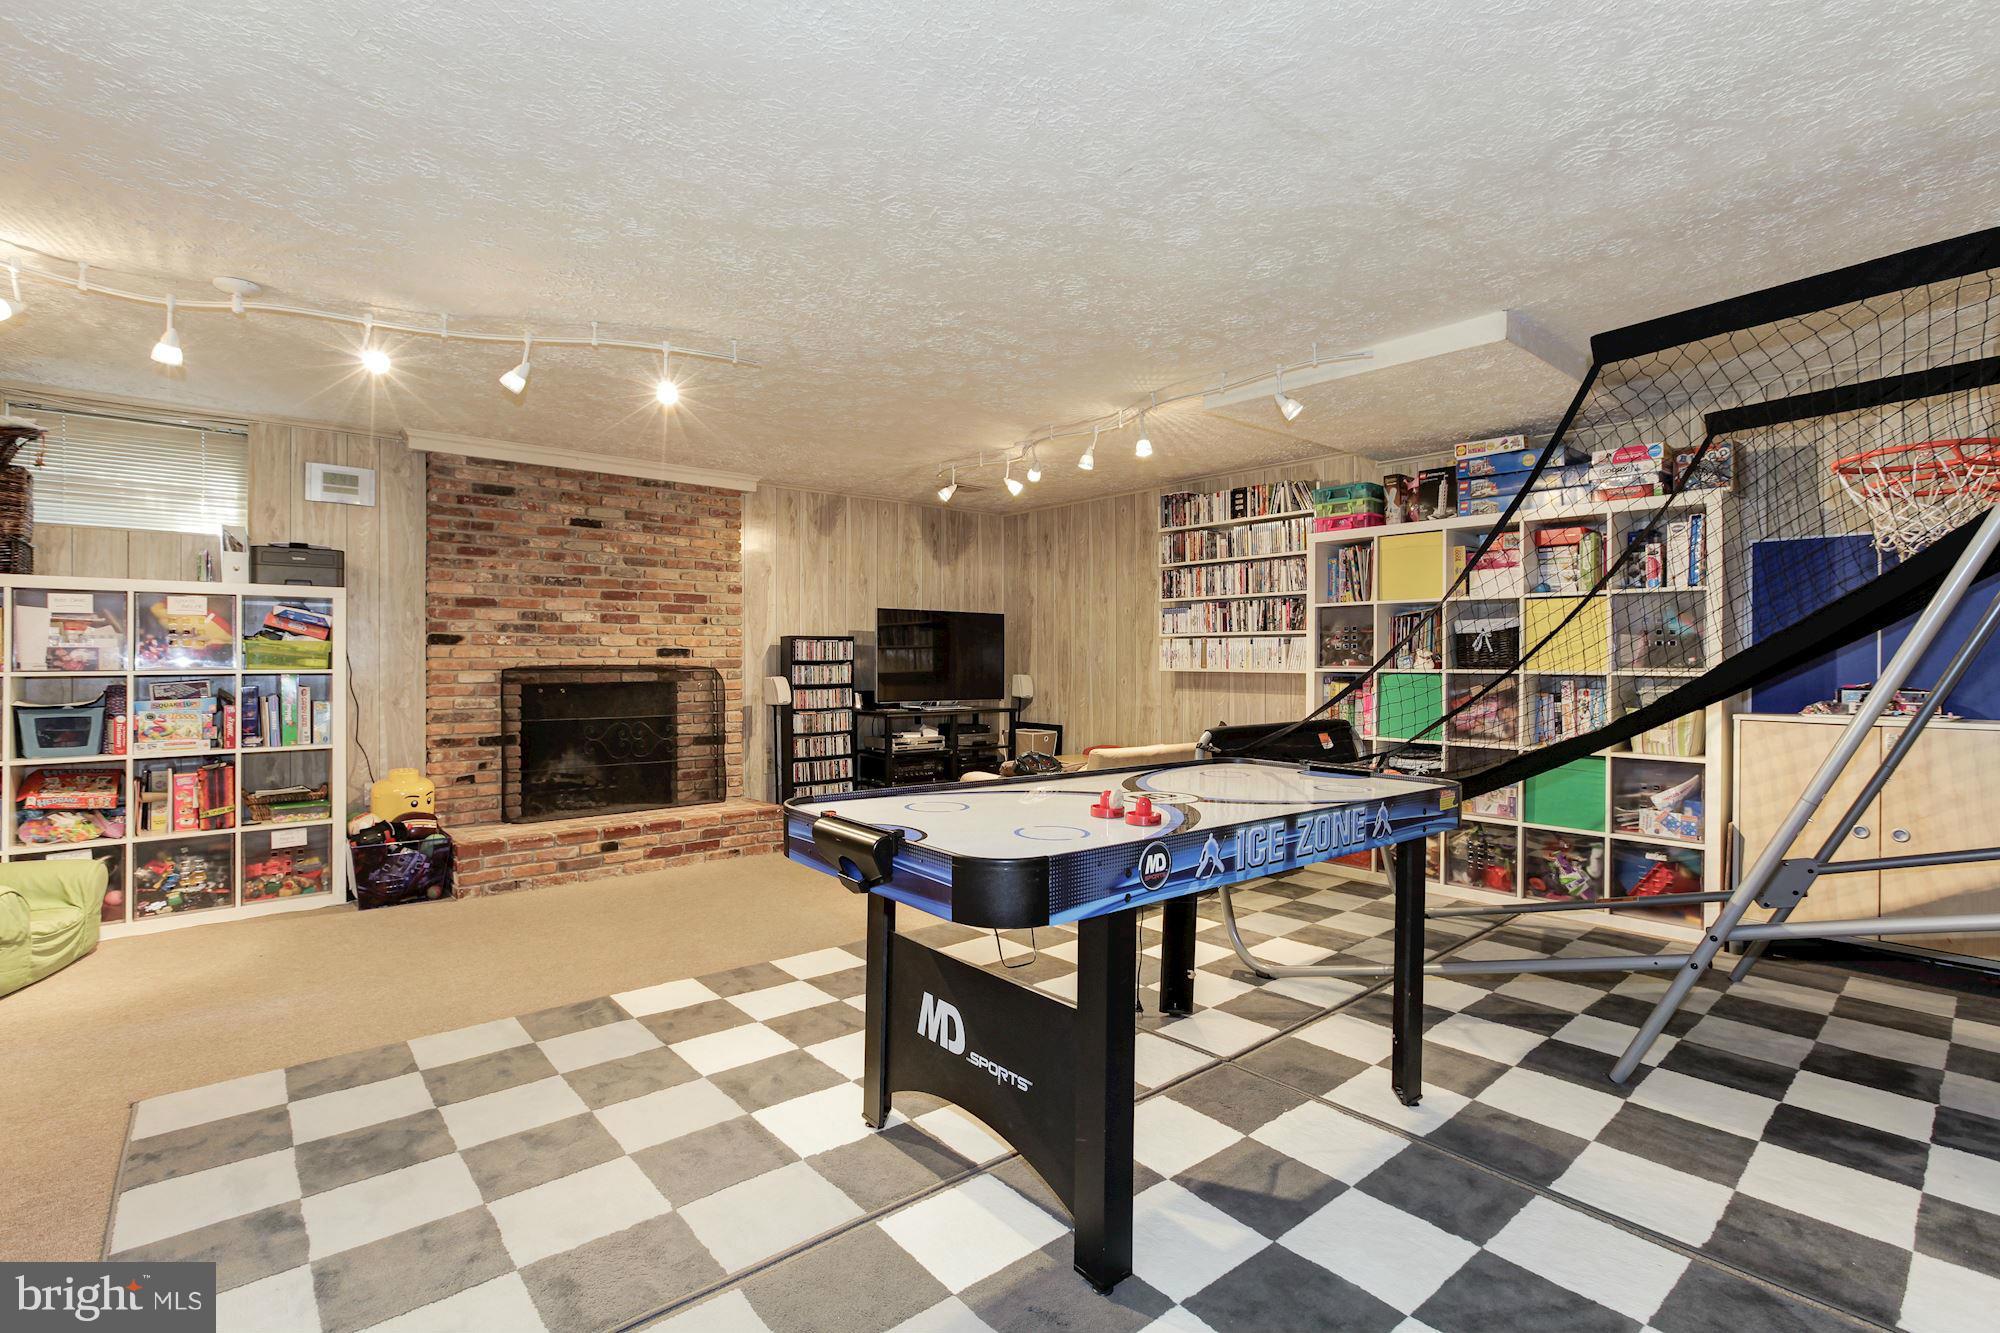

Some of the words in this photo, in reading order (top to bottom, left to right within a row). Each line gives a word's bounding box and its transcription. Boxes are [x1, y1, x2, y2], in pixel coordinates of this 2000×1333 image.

[1145, 853, 1167, 875] MD
[1236, 821, 1287, 871] ICE
[1296, 807, 1367, 858] ZONE
[917, 991, 966, 1055] MD
[966, 1051, 1034, 1092] SPORTS
